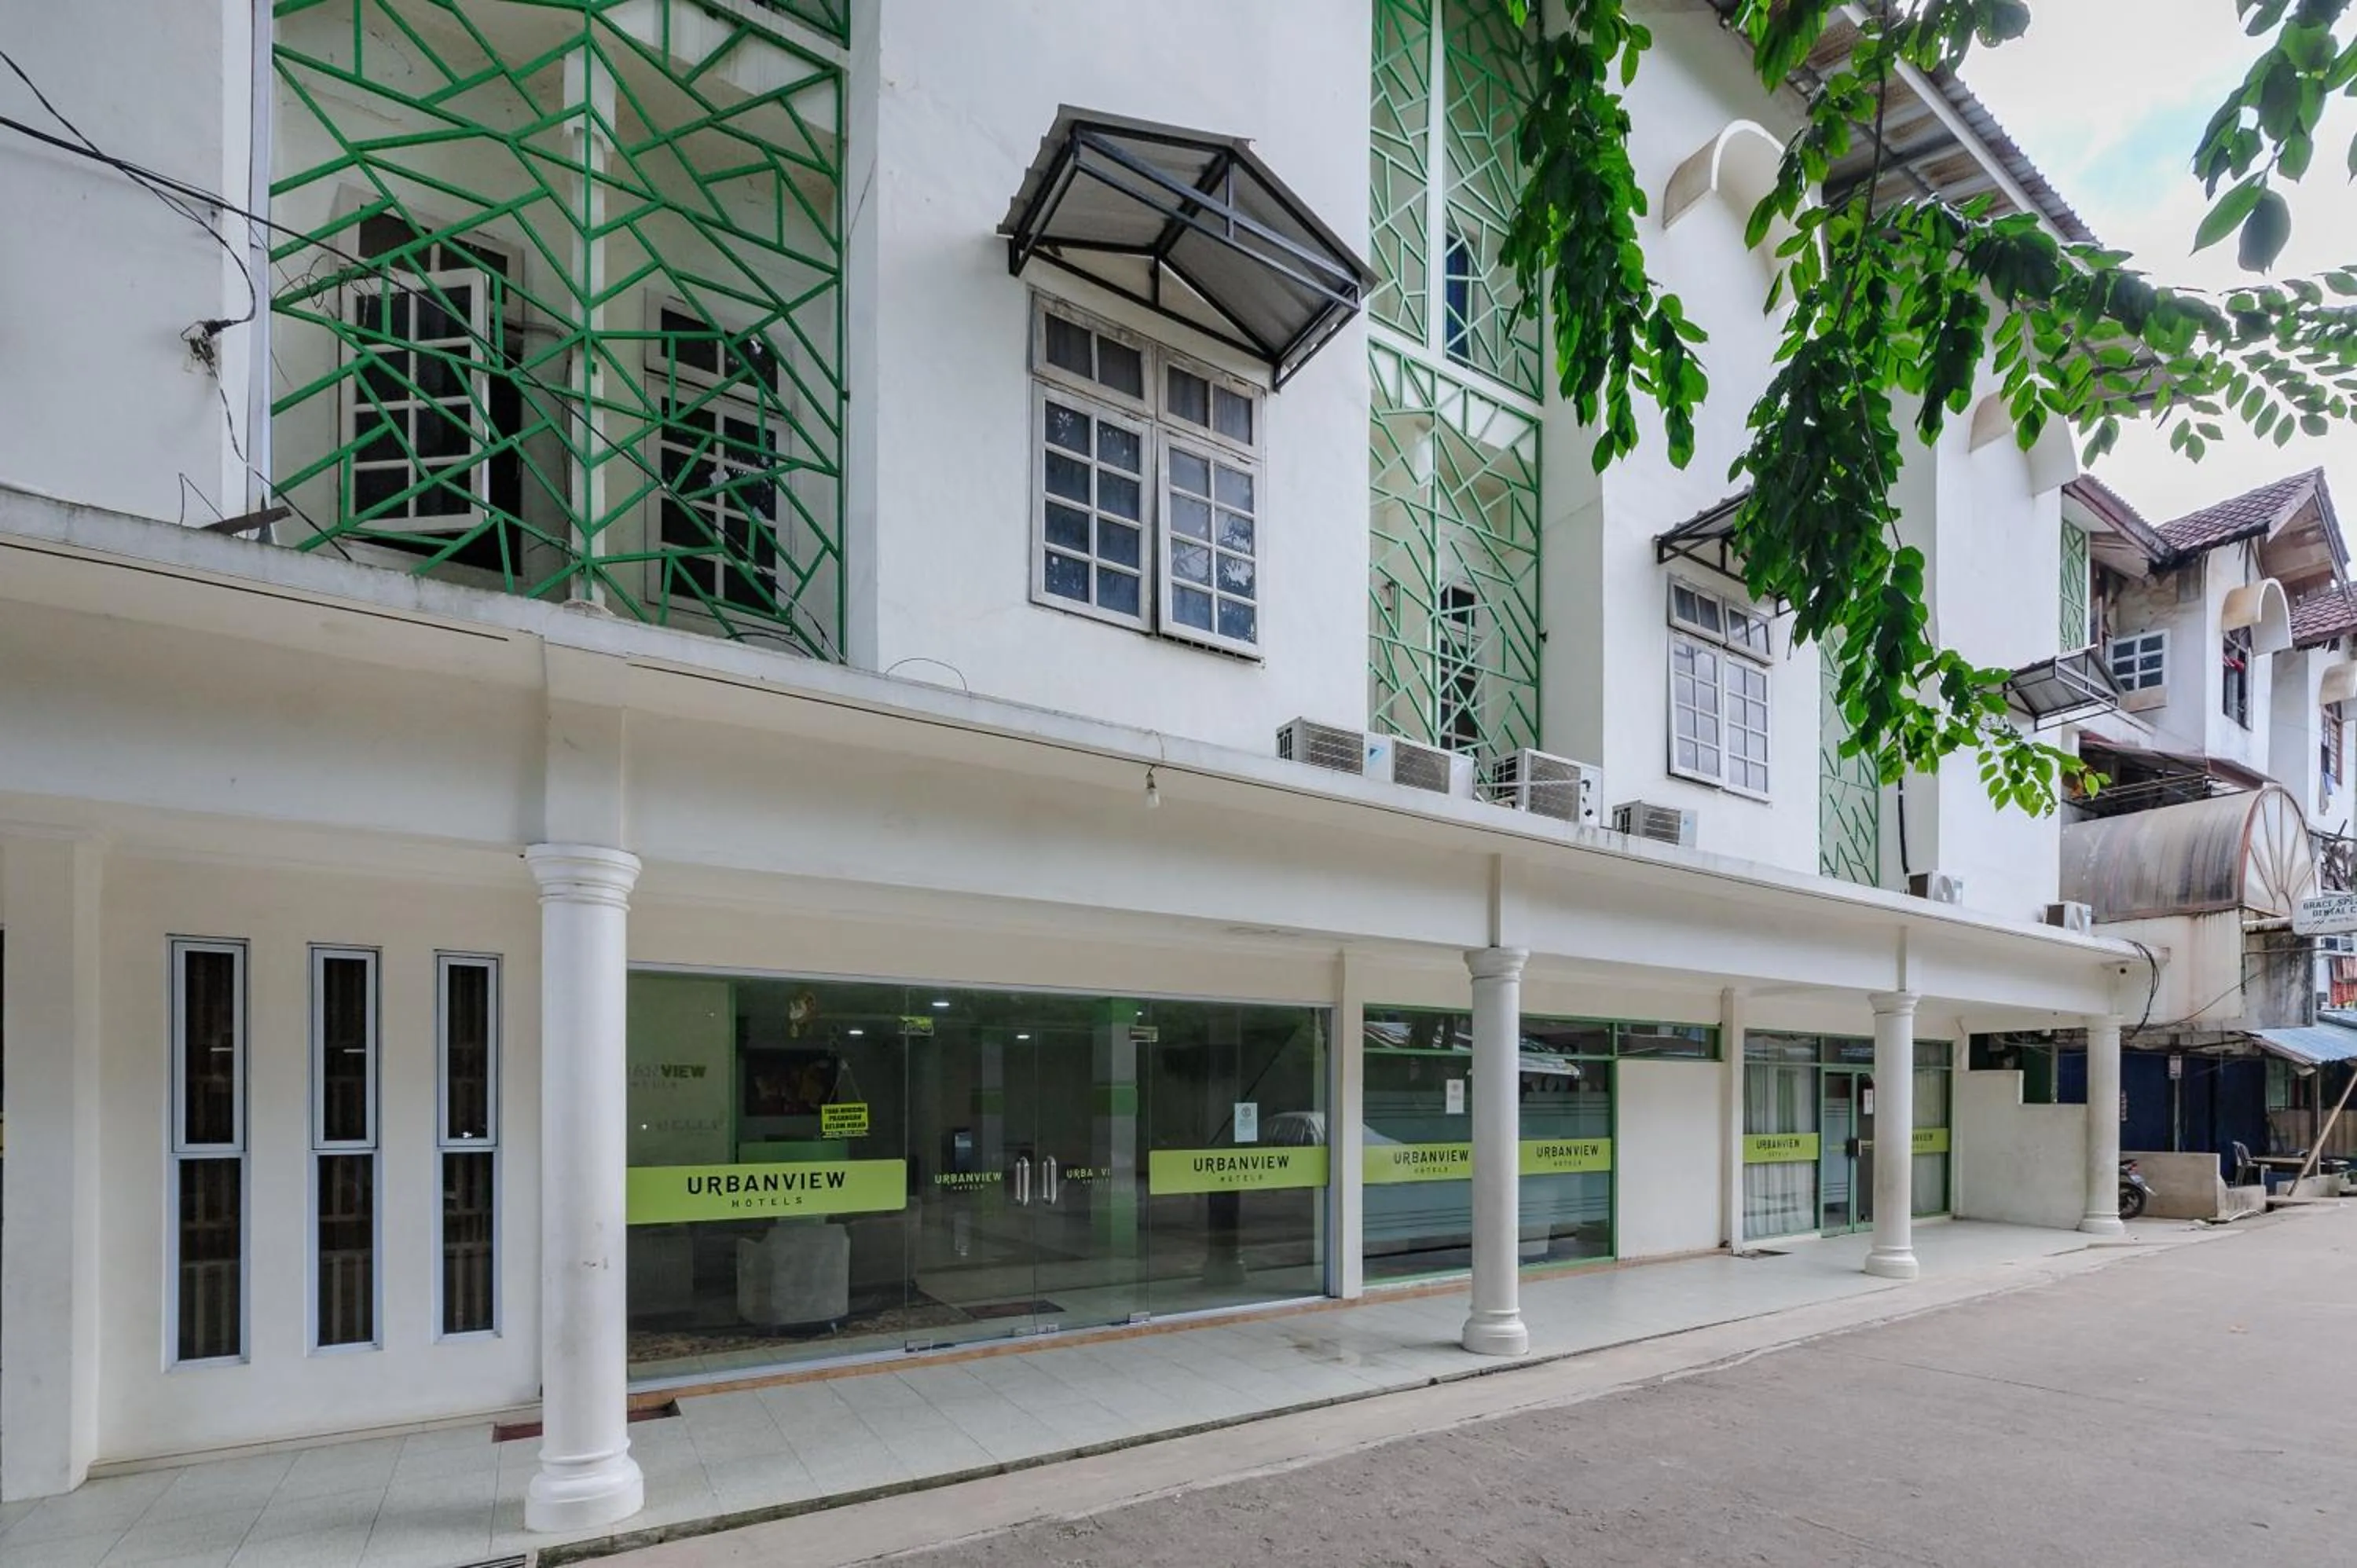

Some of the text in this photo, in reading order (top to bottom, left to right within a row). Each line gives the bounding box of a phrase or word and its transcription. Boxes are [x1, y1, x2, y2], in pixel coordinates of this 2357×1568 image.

[1394, 1149, 1469, 1165] URBANVIEW
[1536, 1145, 1599, 1159] URBANVIEW
[1193, 1156, 1289, 1174] URBANVIEW
[687, 1171, 845, 1196] URBANVIEW
[934, 1171, 1002, 1185] URBANVIEW
[731, 1196, 803, 1207] HOTELS
